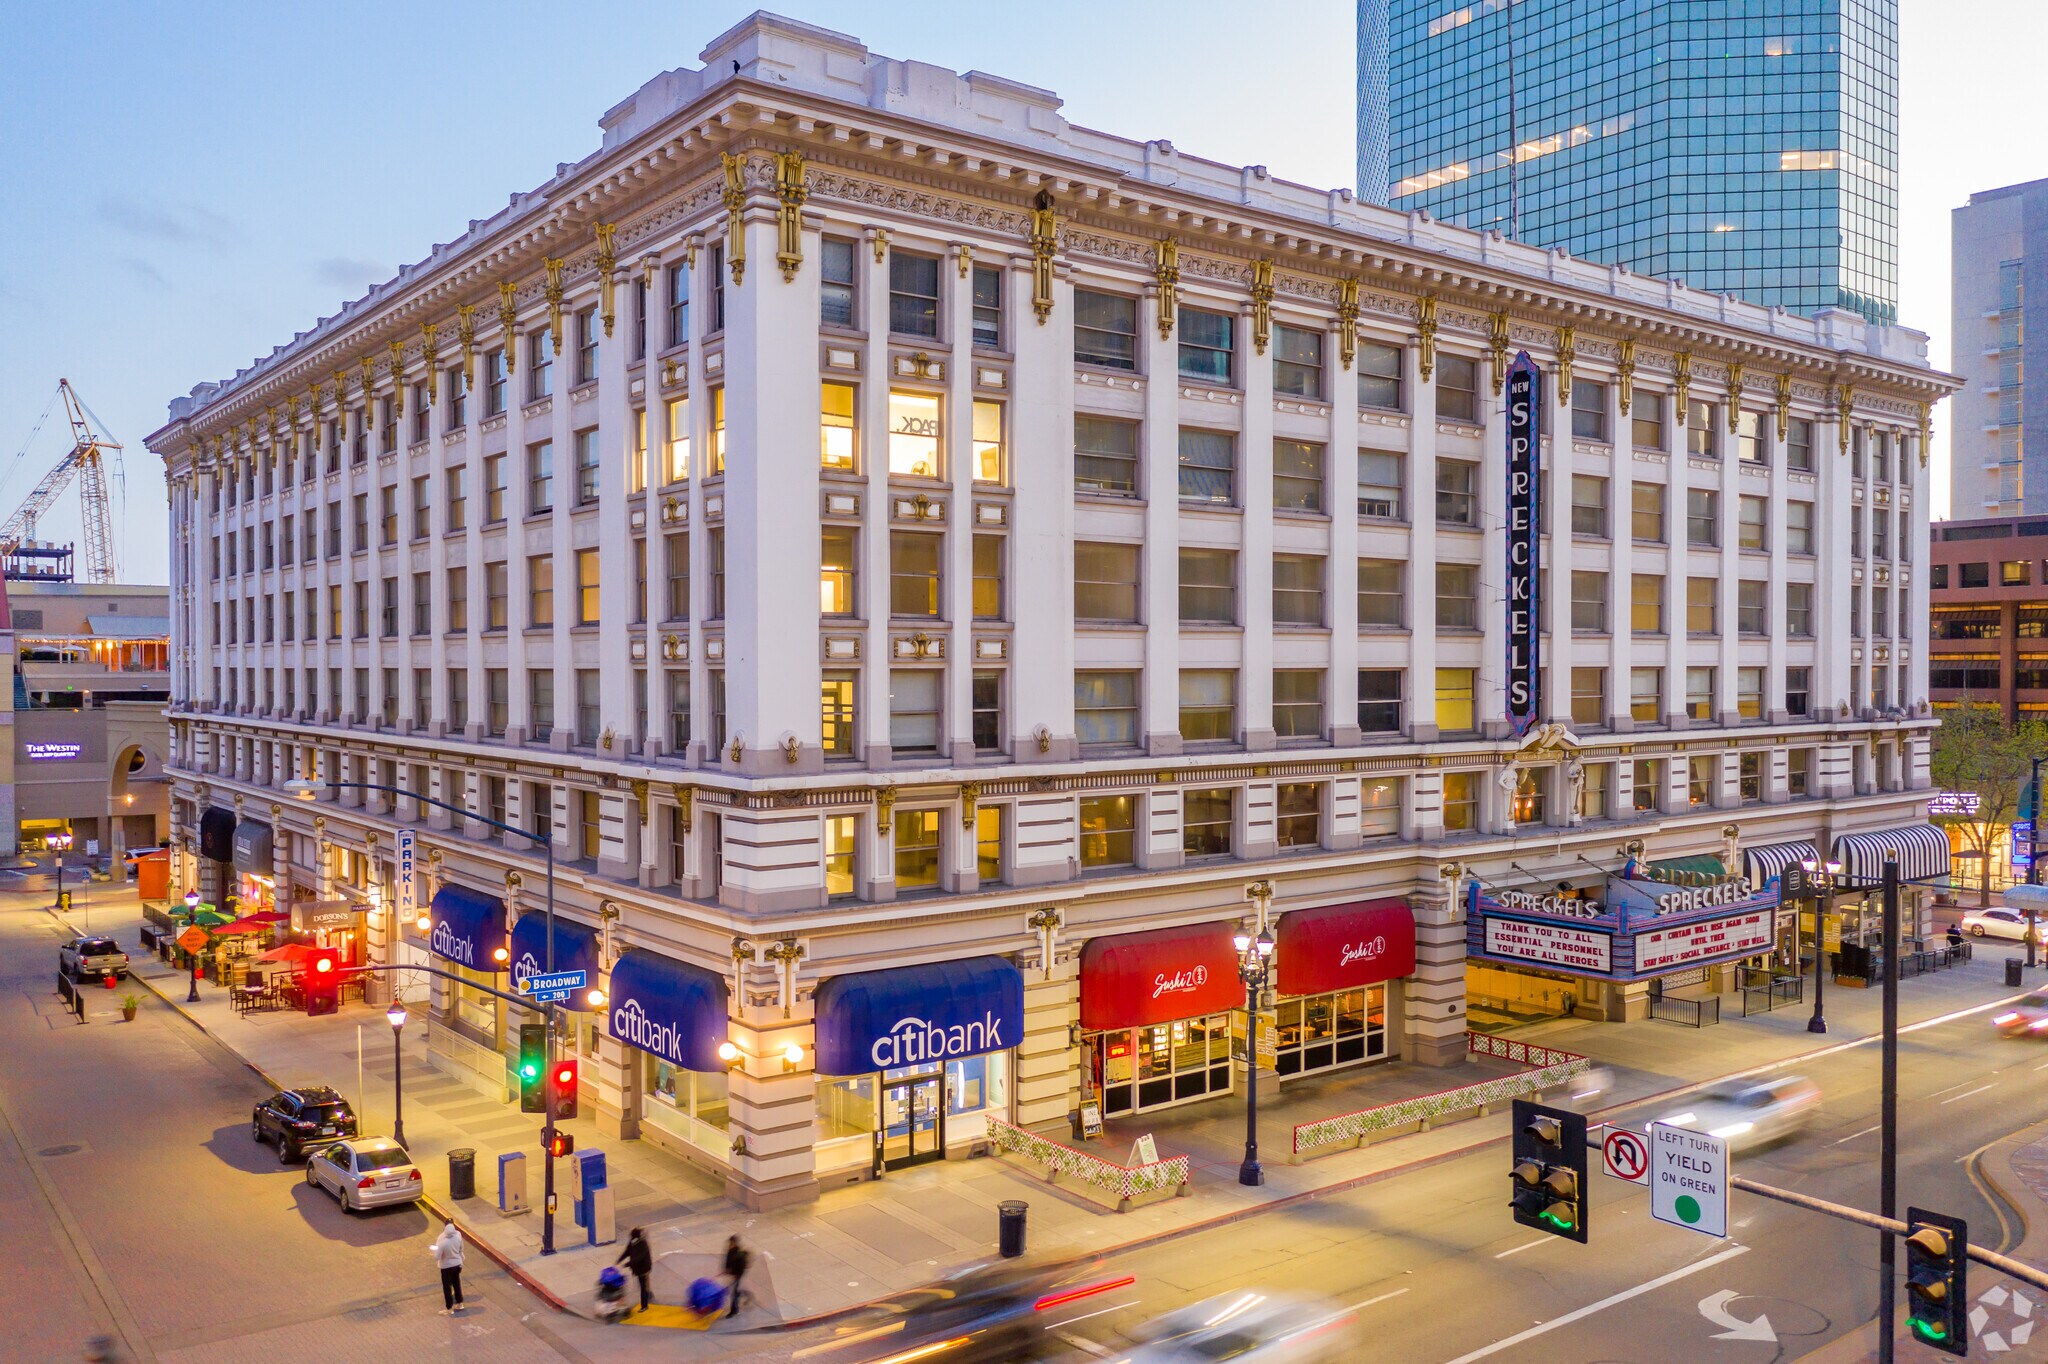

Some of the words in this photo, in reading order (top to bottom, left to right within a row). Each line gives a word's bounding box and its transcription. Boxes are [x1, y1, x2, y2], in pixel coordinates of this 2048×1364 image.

[1511, 381, 1529, 394] NEW
[1511, 402, 1529, 705] SPRECKELS
[25, 744, 45, 752] THE
[45, 744, 81, 752] WESTIN
[402, 838, 412, 918] PARKING
[1500, 890, 1598, 919] SPRECKELS
[1659, 881, 1752, 915] SPRECKELS
[313, 912, 349, 922] DOBSON'S
[1501, 922, 1530, 934] THANK
[1535, 927, 1552, 937] YOU
[1558, 930, 1570, 940] TO
[1575, 933, 1593, 943] ALL
[1650, 934, 1662, 943] OUR
[1667, 928, 1691, 940] CURTAIN
[1694, 925, 1708, 934] WILL
[1711, 922, 1724, 931] RISE
[1726, 918, 1742, 928] AGAIN
[1745, 915, 1760, 925] SOON
[1690, 936, 1708, 946] UNTIL
[1710, 933, 1725, 943] THEN
[433, 920, 474, 965] citibank
[1494, 932, 1543, 947] ESSENTIAL
[1551, 942, 1604, 956] PERSONNEL
[1643, 957, 1657, 968] STAY
[1658, 954, 1674, 964] SAFE
[1680, 949, 1701, 960] SOCIAL
[1703, 942, 1731, 955] DISTANCE
[1737, 939, 1750, 948] STAY
[1751, 936, 1766, 945] WELL
[1496, 944, 1514, 953] YOU
[1520, 948, 1536, 957] ARE
[1541, 951, 1558, 960] ALL
[1564, 955, 1599, 967] HEROES
[533, 975, 581, 990] BROADWAY
[552, 991, 565, 999] 200
[615, 998, 682, 1062] citibank
[871, 1010, 1002, 1067] citibank
[1265, 1026, 1275, 1057] CENTER
[1111, 1047, 1125, 1056] OPEN
[1256, 1036, 1266, 1055] CITY
[1658, 1131, 1684, 1146] LEFT
[1689, 1138, 1718, 1154] TURN
[1665, 1151, 1712, 1174] YIELD
[1661, 1172, 1676, 1184] ON
[1680, 1177, 1716, 1194] GREEN
